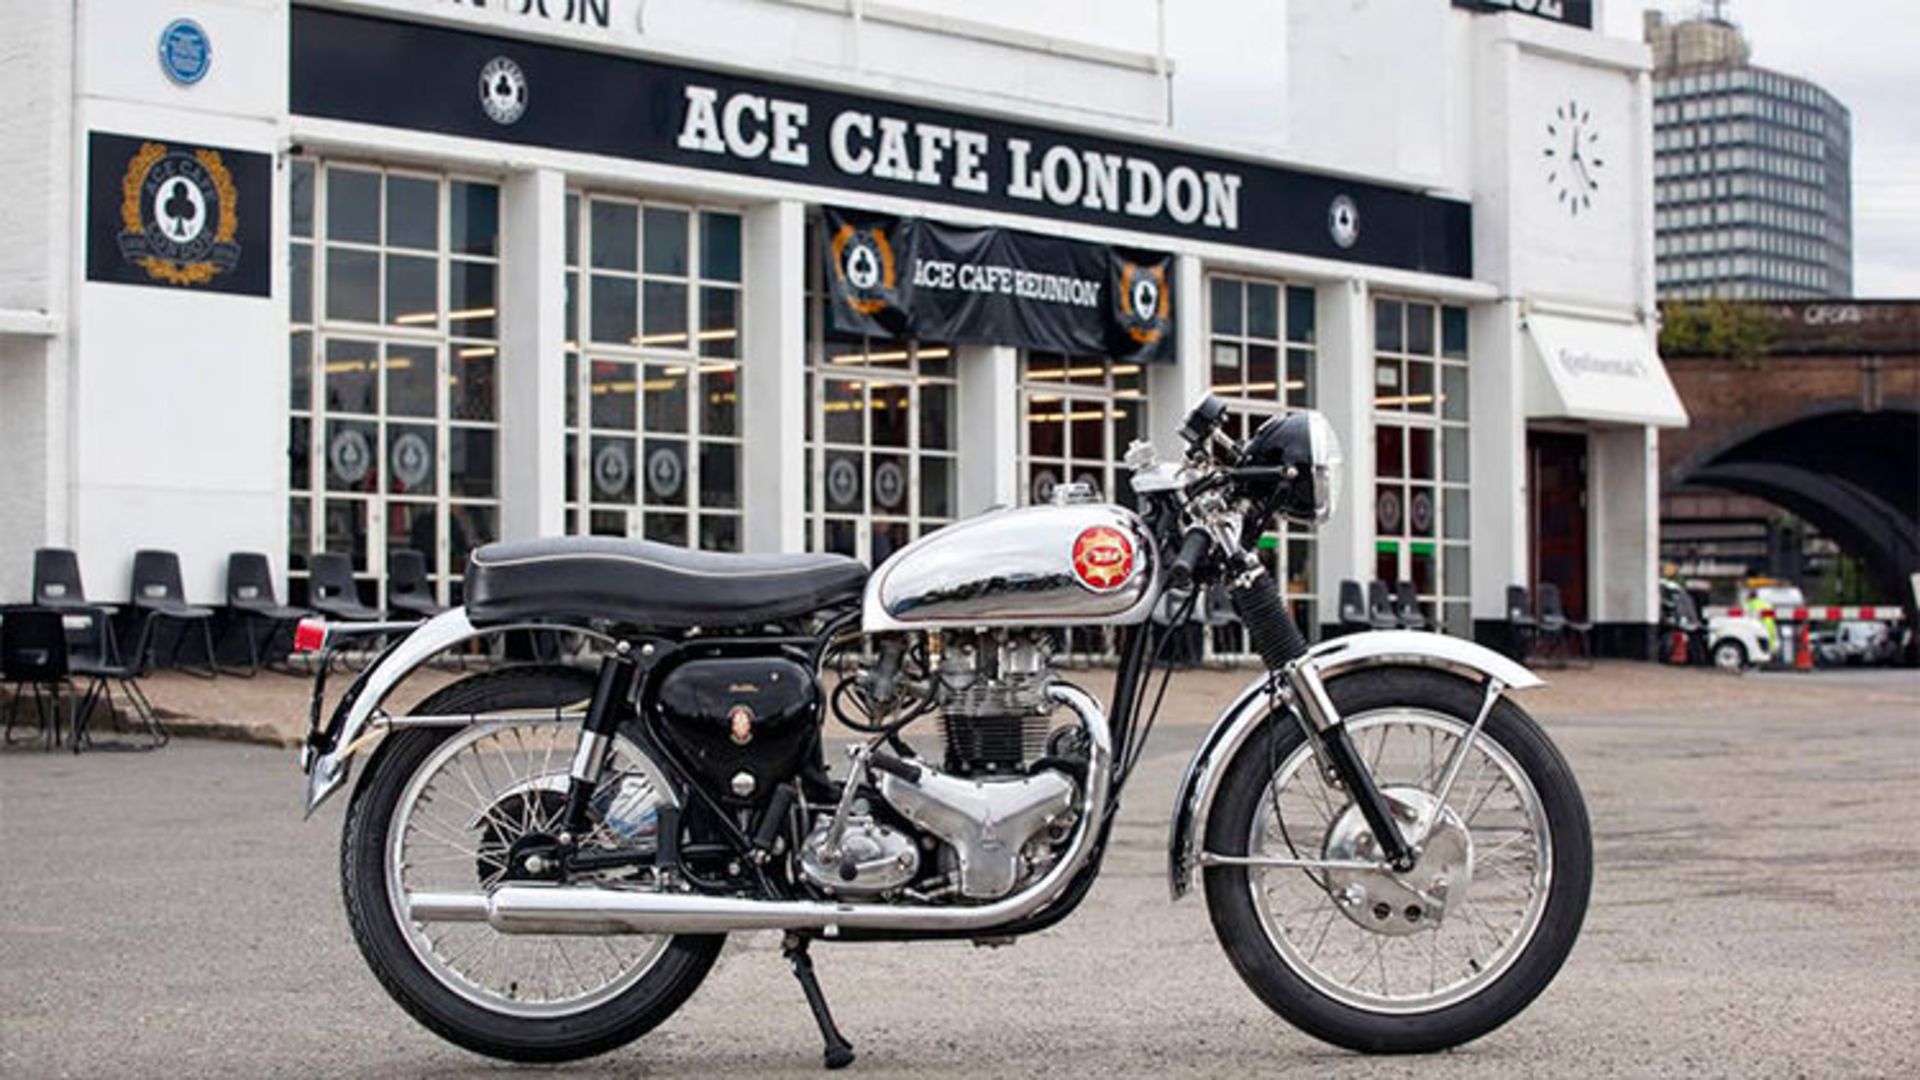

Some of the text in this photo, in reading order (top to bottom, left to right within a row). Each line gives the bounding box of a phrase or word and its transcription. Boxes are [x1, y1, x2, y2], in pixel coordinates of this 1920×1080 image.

[677, 85, 809, 165] ACE
[830, 110, 989, 193] CAFE
[1007, 138, 1242, 230] LONDON
[913, 259, 1100, 308] ACE CAFE REUNION
